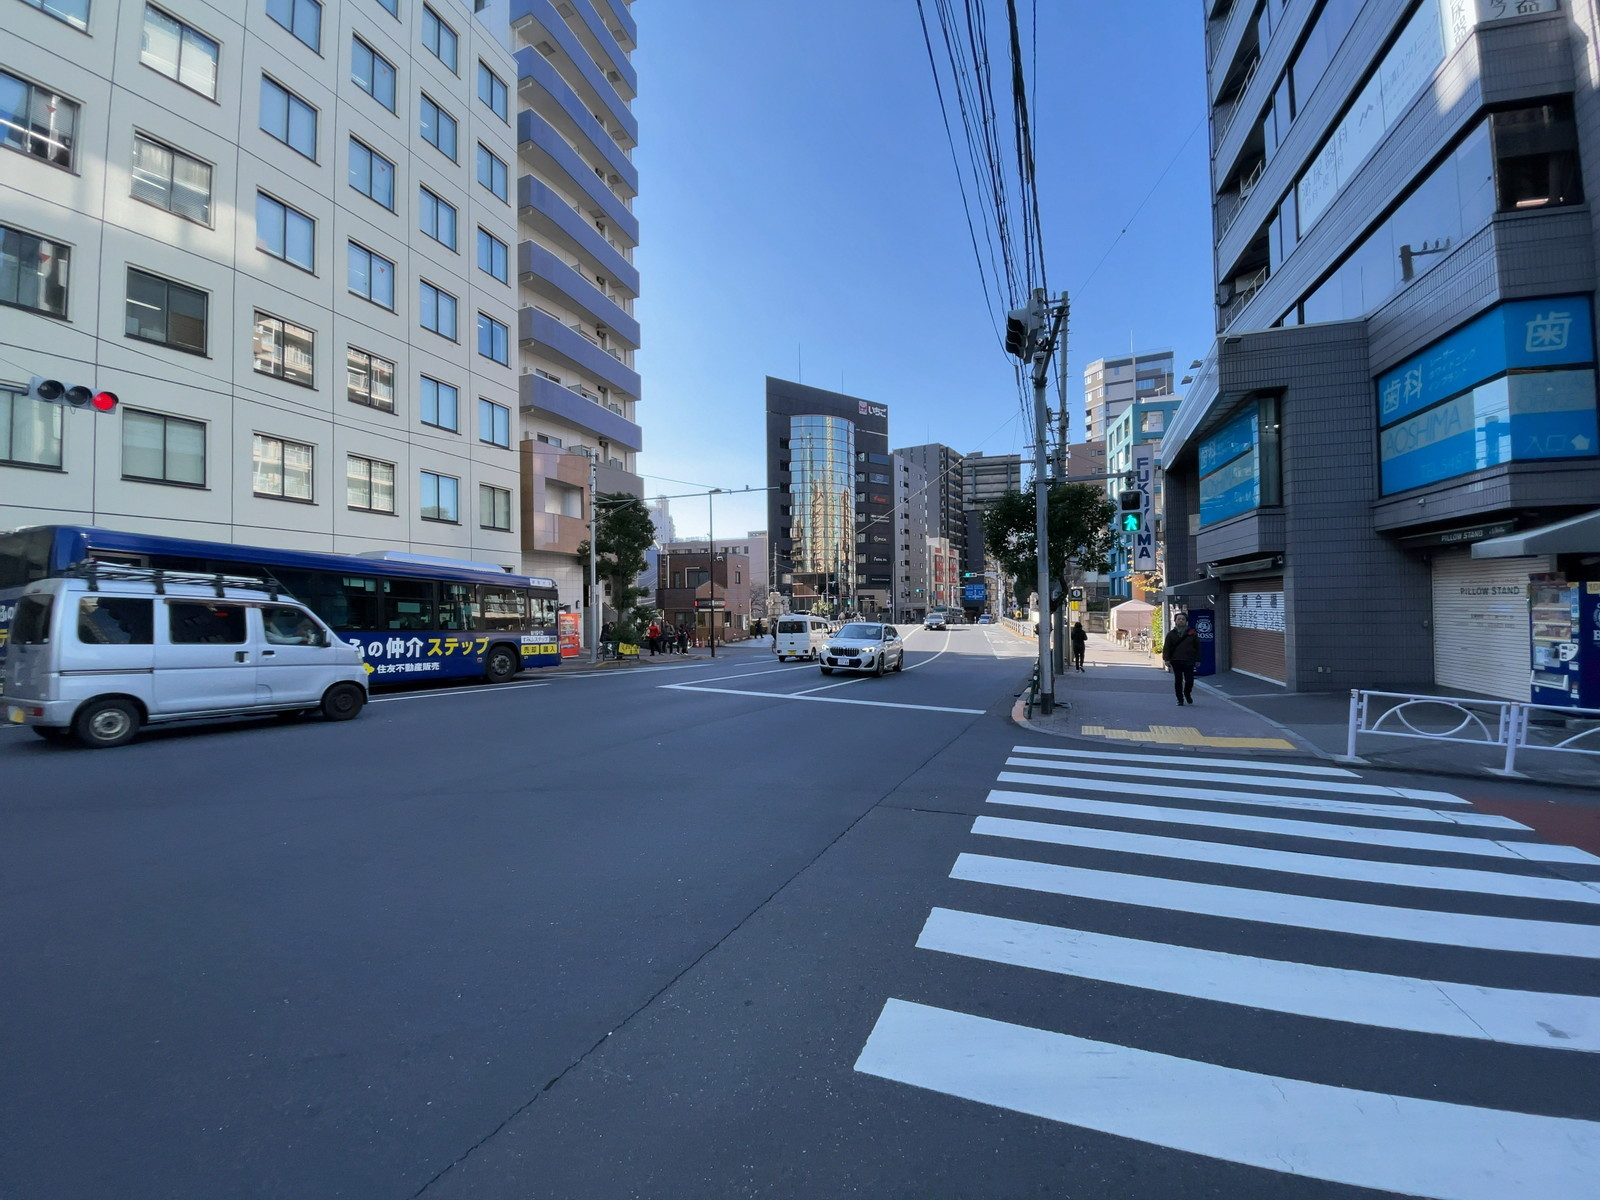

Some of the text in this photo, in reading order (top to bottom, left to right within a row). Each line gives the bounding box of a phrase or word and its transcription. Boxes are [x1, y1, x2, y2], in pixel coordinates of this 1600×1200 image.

[1525, 311, 1573, 352] 歯
[1383, 363, 1423, 415] 歯科
[1384, 404, 1464, 454] AOSHIMA
[1522, 434, 1567, 456] 入口
[1136, 457, 1152, 559] FUKMA
[1463, 529, 1483, 539] STAND
[1460, 585, 1520, 596] PILLOW STAND
[377, 662, 440, 674] 住友不動産販売
